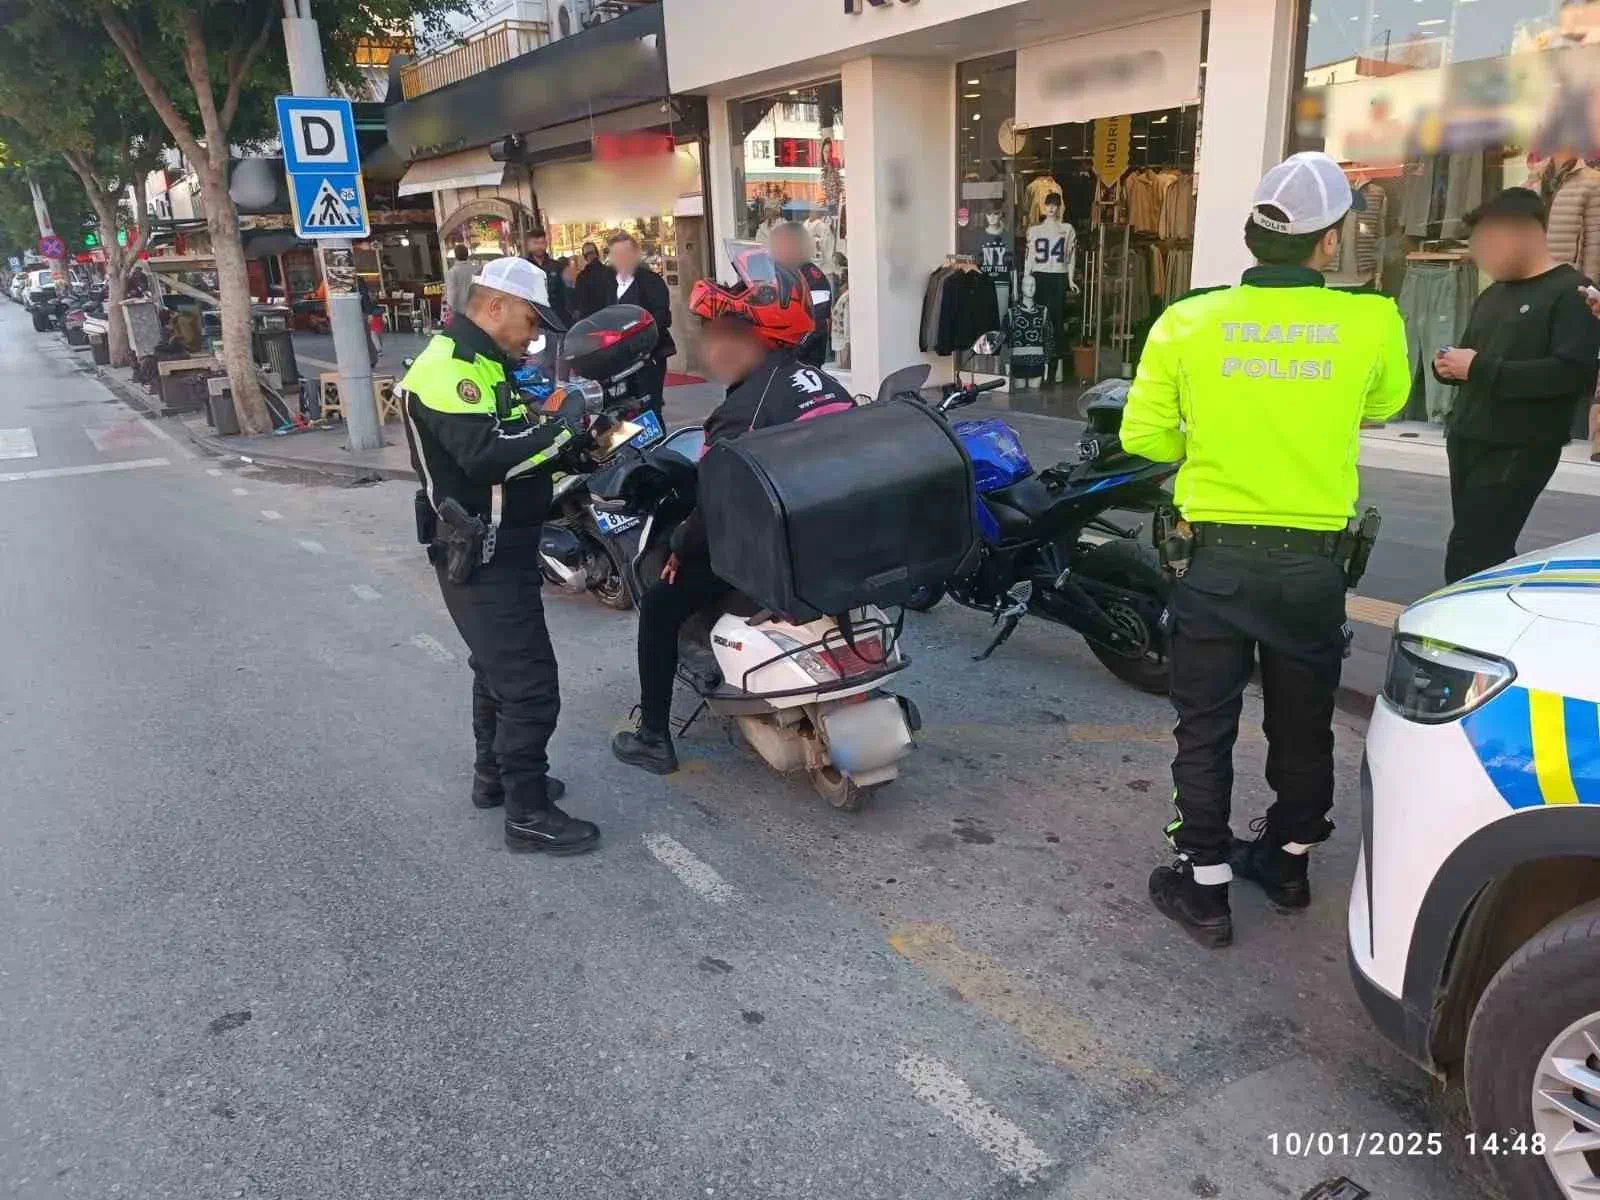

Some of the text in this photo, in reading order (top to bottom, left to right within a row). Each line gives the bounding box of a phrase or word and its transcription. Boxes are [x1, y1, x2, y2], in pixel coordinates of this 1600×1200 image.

[301, 116, 336, 156] D
[982, 247, 1006, 266] NY
[1034, 238, 1065, 263] 94
